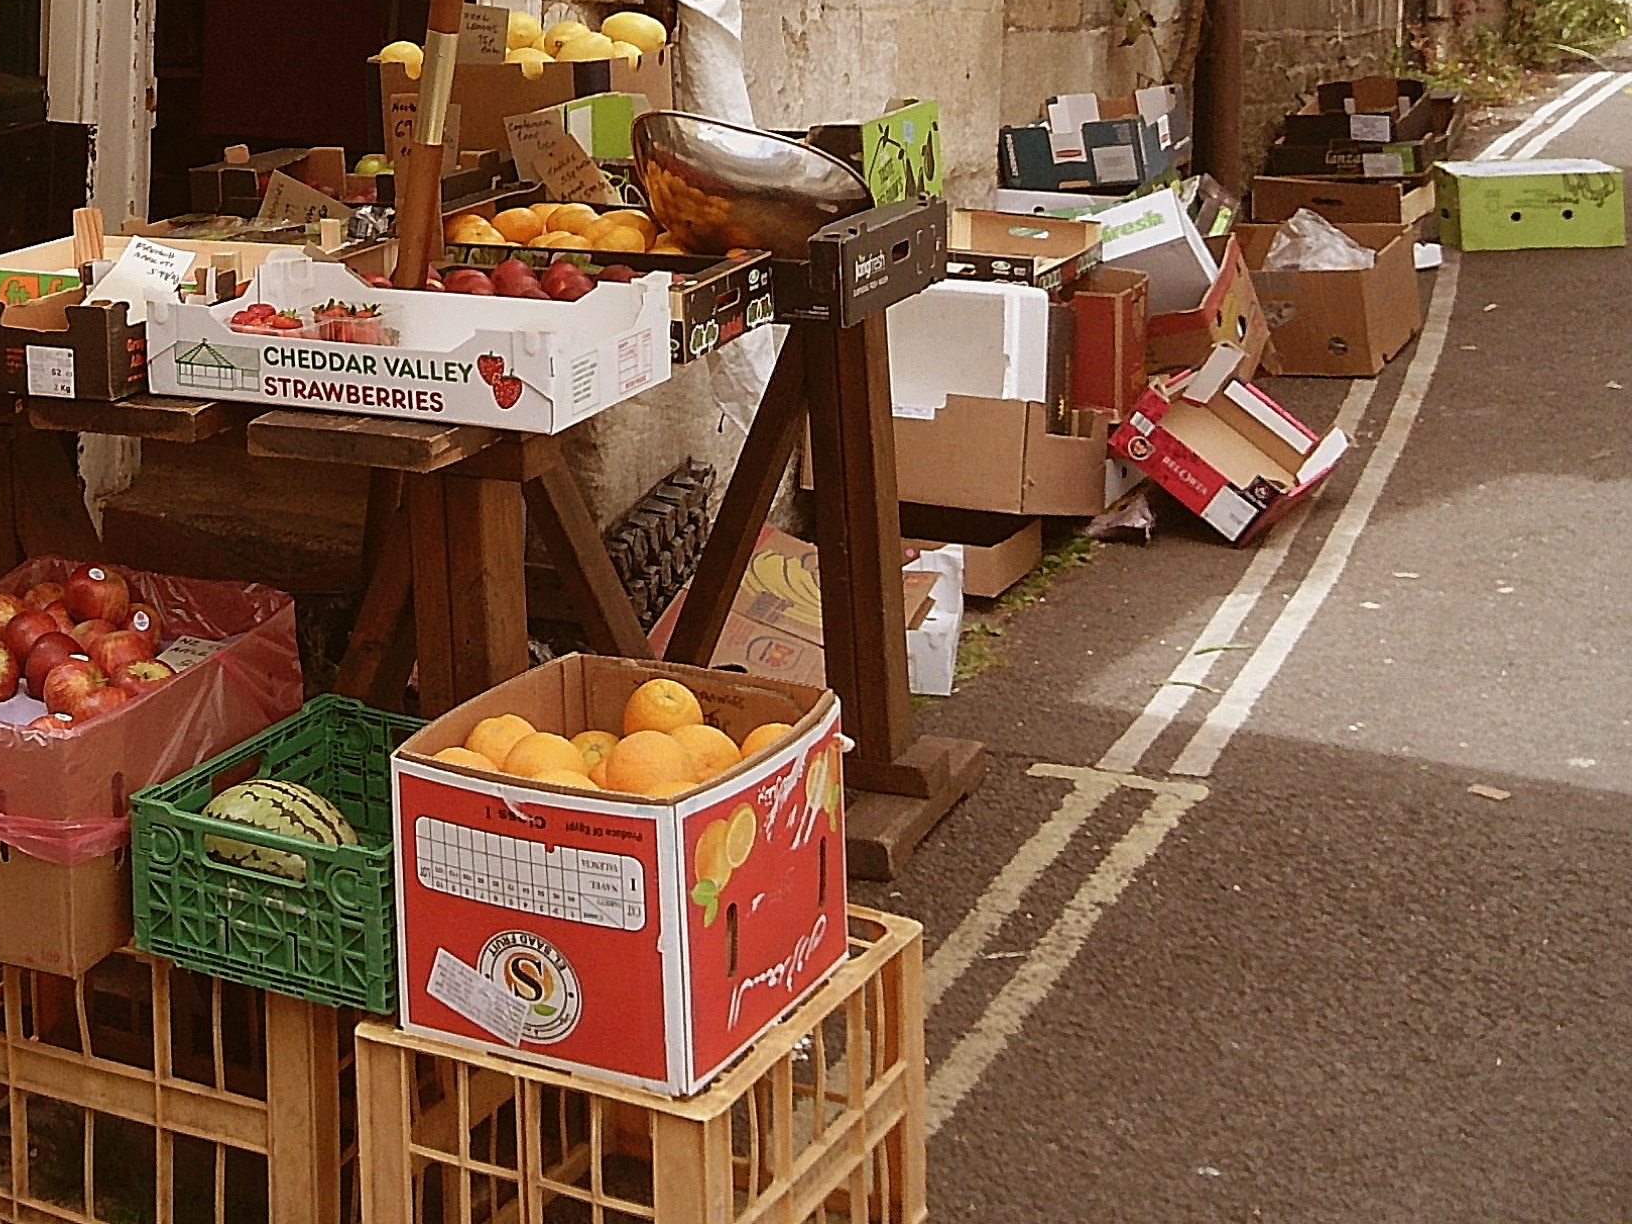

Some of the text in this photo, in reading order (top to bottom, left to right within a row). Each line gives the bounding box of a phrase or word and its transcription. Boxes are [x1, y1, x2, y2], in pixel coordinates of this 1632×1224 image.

[263, 346, 473, 384] CHEDDAR VALLEY
[264, 376, 444, 413] STRAWBERRIES
[498, 808, 547, 830] Class
[565, 821, 644, 843] Produce Of Egypt
[579, 857, 619, 873] VALENCIA
[589, 879, 619, 894] NAVEL
[487, 932, 568, 972] FRUIT SAAD EL
[510, 956, 544, 1003] S
